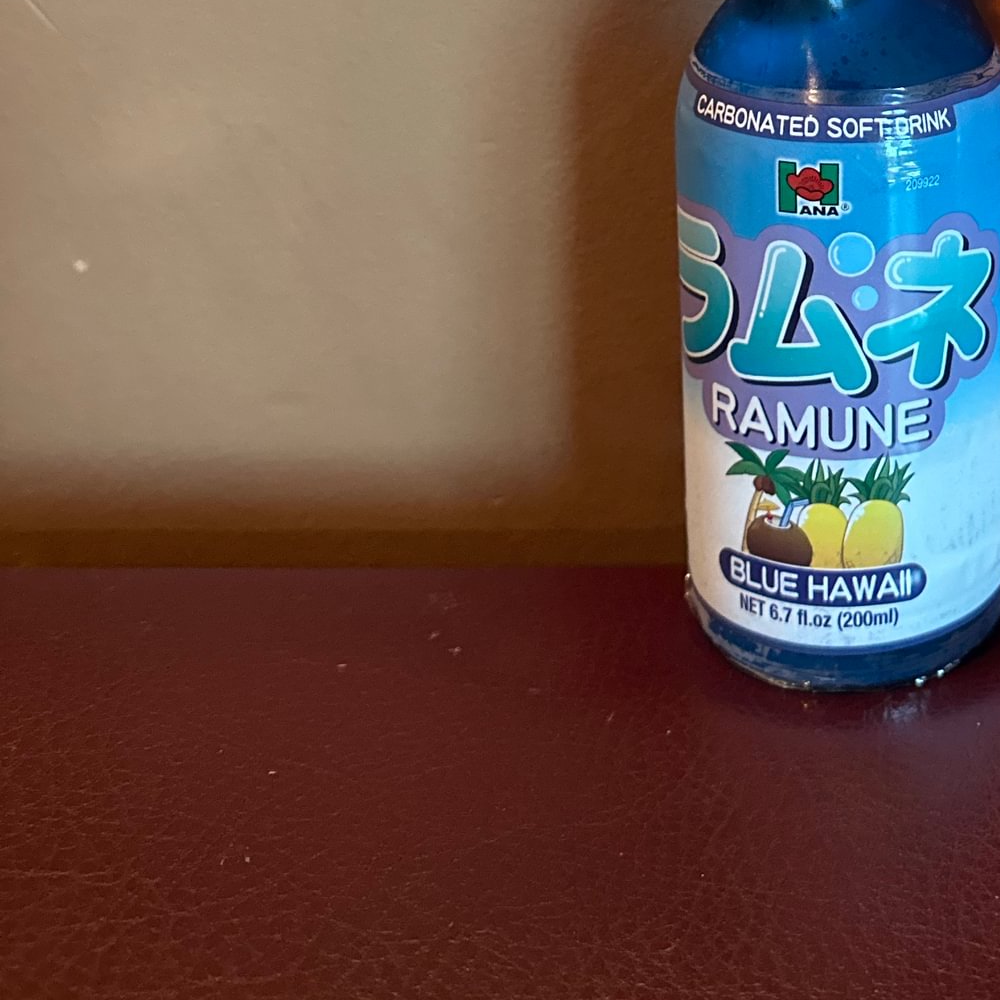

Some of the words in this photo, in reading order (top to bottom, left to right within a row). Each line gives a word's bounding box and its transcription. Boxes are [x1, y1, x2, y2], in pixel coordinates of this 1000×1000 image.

[697, 94, 820, 137] CARBONATED
[826, 116, 886, 138] SOFT
[895, 107, 951, 136] DRINK
[905, 175, 940, 191] 209922
[678, 204, 993, 396] ラムネ
[711, 381, 933, 451] RAMUNE
[730, 554, 799, 597] BLUE
[807, 574, 913, 602] HAWAII
[739, 592, 765, 616] NET
[769, 603, 793, 623] 6.7
[797, 608, 832, 628] fl.oz
[837, 607, 899, 631] (200ml)
